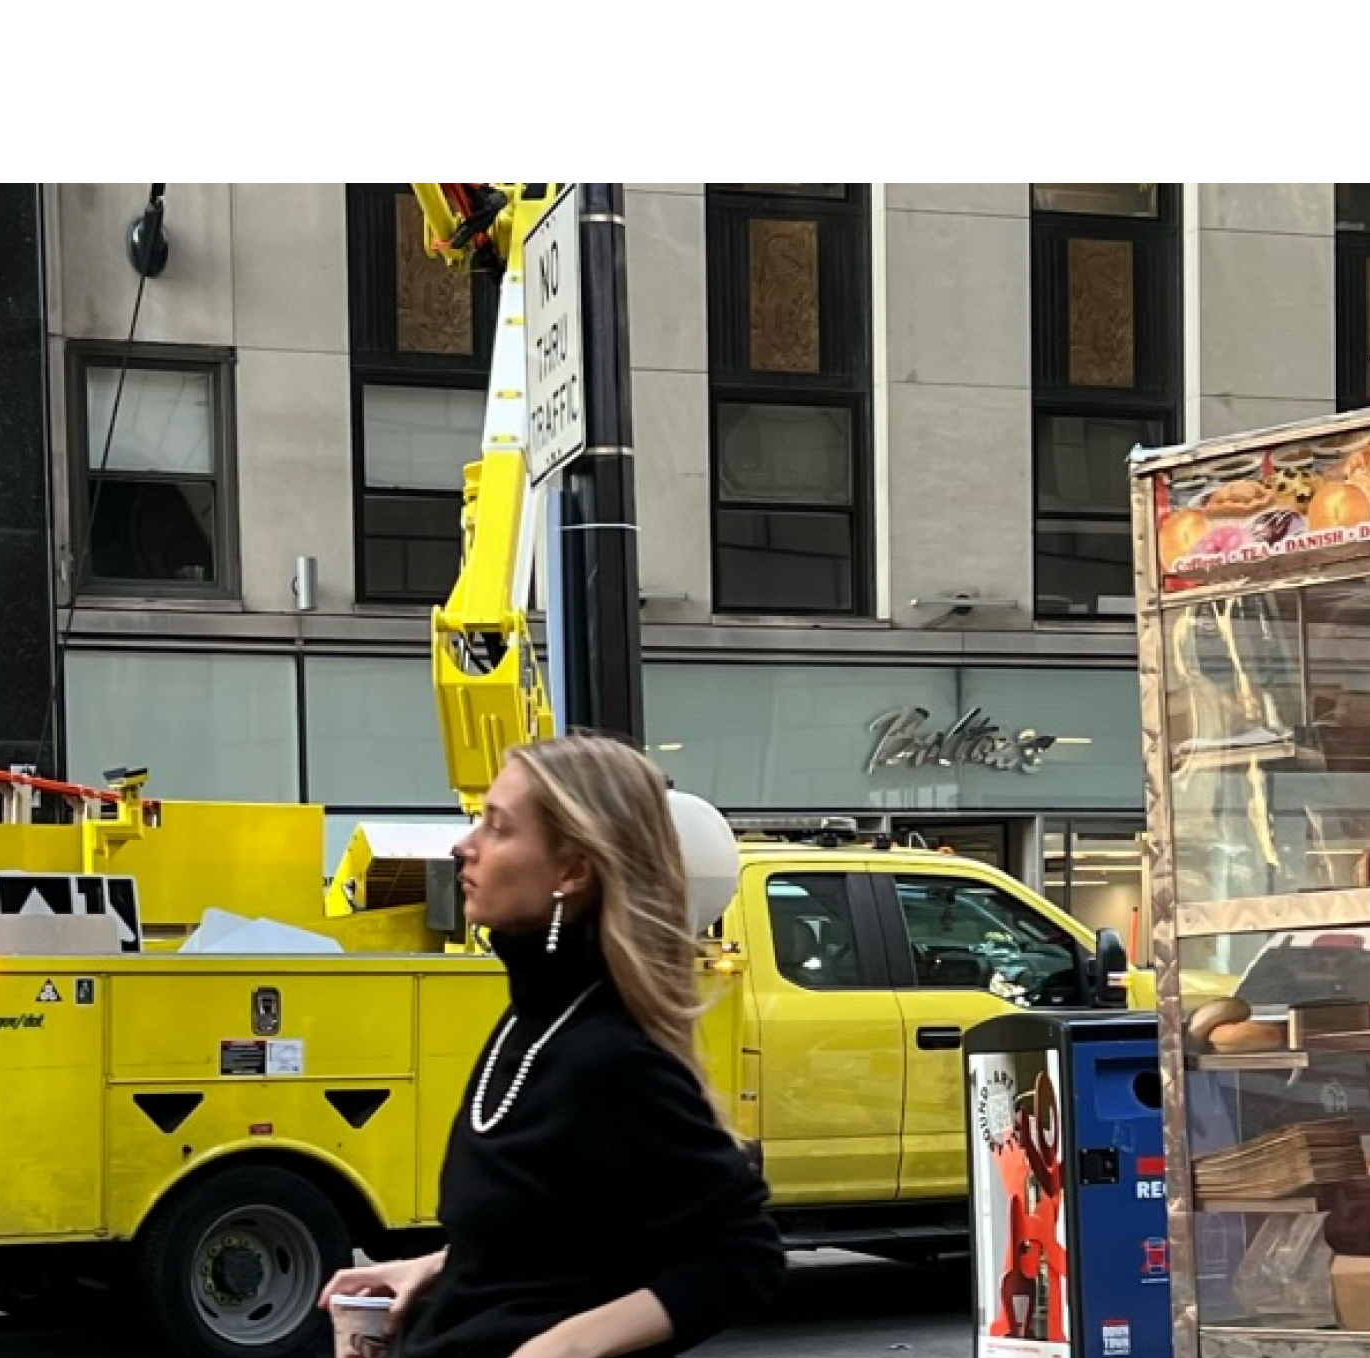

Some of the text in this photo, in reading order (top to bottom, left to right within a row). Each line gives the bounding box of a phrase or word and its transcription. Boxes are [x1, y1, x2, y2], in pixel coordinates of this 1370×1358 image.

[538, 239, 560, 309] NO
[536, 313, 568, 382] THRU
[531, 373, 579, 448] TRAFFIC
[1241, 545, 1271, 562] TEA
[1284, 530, 1345, 553] DANISH
